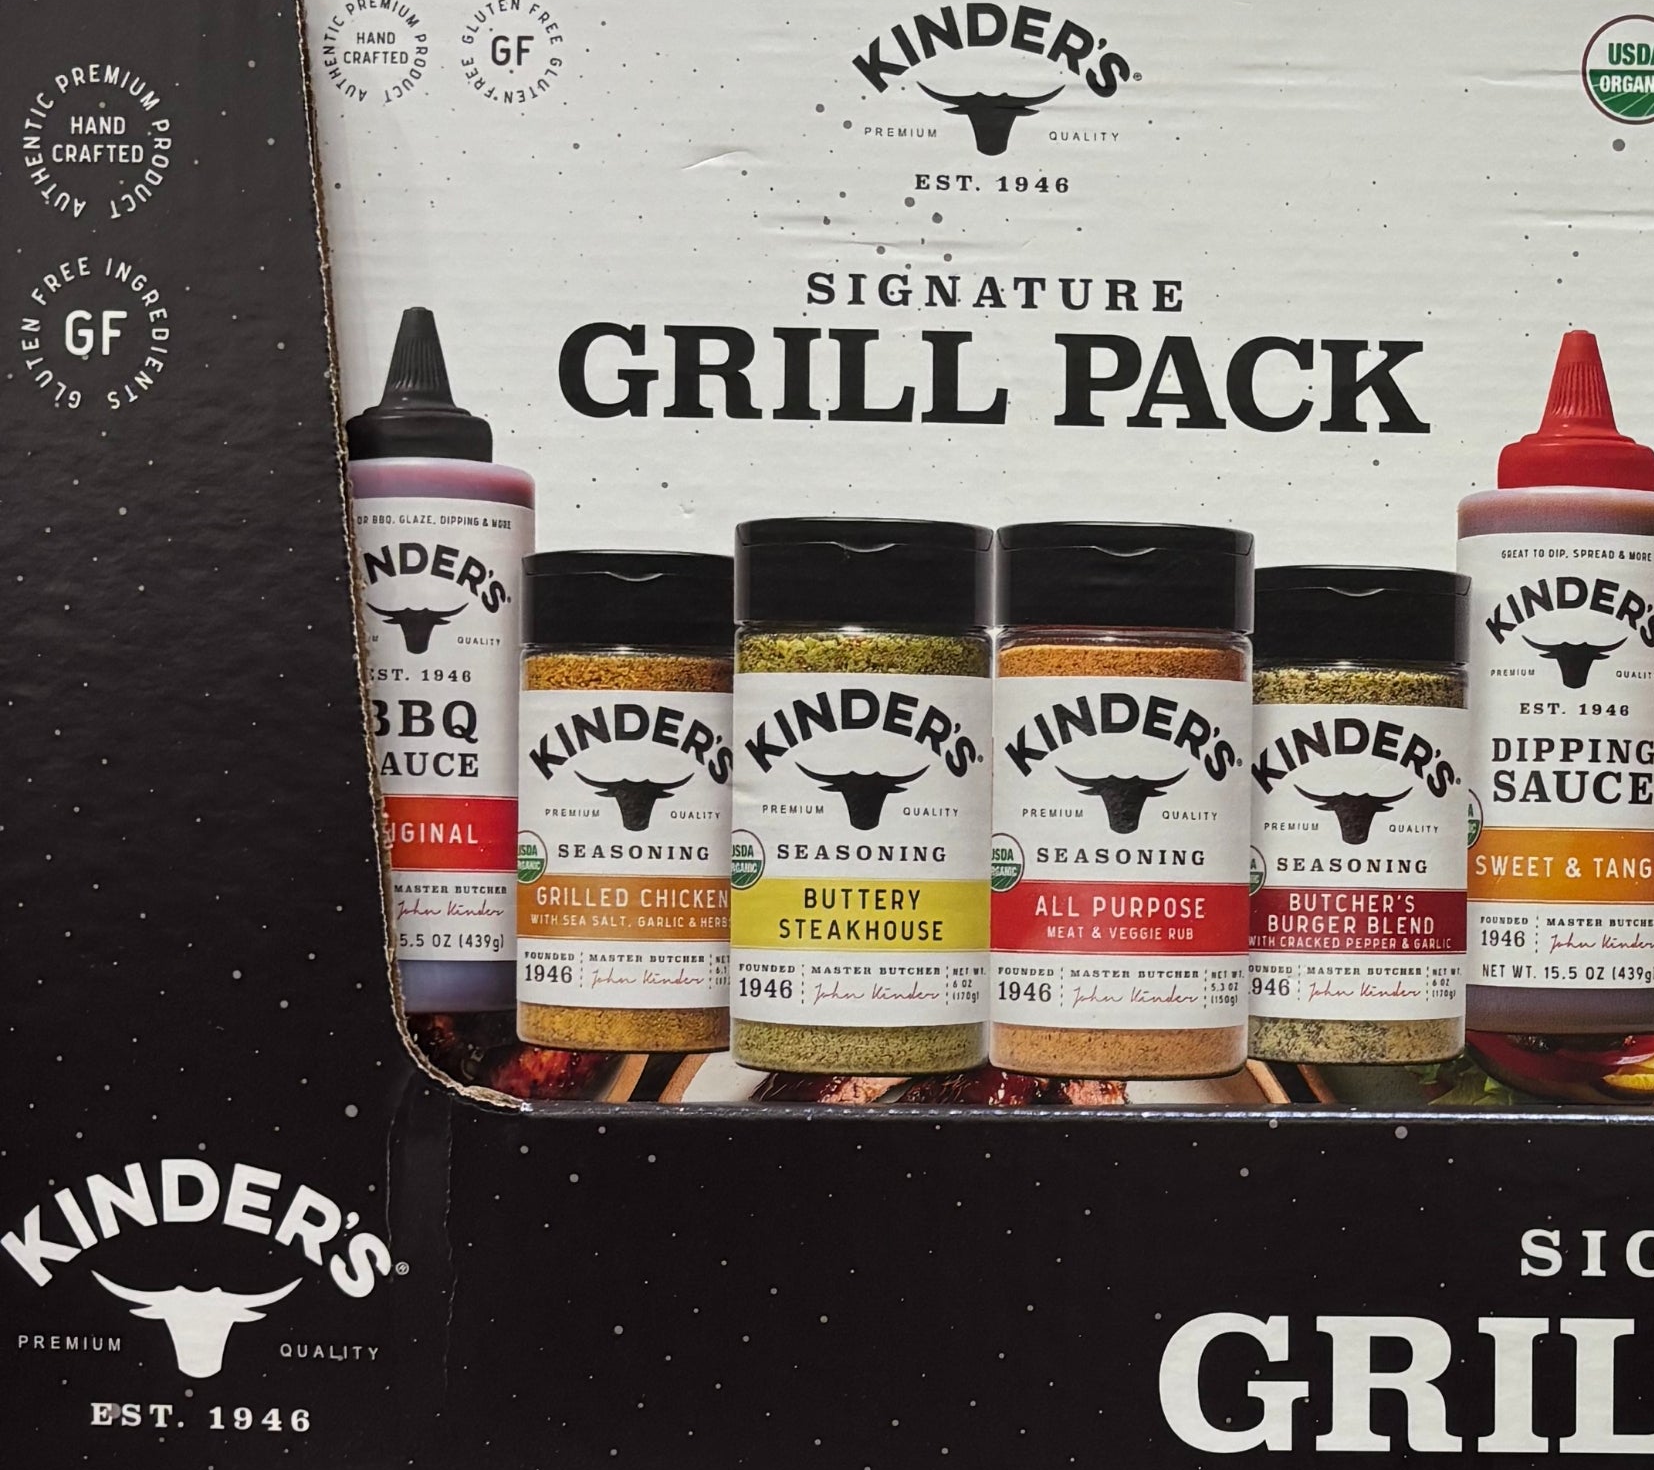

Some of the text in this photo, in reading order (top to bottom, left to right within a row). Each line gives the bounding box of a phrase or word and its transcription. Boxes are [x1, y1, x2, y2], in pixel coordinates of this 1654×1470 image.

[356, 31, 396, 45] HAND
[343, 51, 409, 64] CRAFTED
[491, 36, 534, 66] GF
[851, 2, 1131, 98] KINDER'S
[70, 116, 127, 135] HAND
[864, 126, 1120, 142] PREMIUM QUALITY
[23, 63, 173, 219] AUTHENTIC PREMIUM PRODUCT
[52, 144, 144, 163] CRAFTED
[914, 174, 1070, 193] EST. 1946
[805, 271, 1187, 314] SIGNATURE
[20, 256, 170, 410] GLUTEN FREE INGREDIENTS
[65, 309, 128, 356] GF
[557, 321, 1432, 434] GRILL PACK
[1501, 549, 1529, 559] GREAT
[1534, 549, 1545, 558] TO
[1573, 550, 1615, 559] SPREAD
[1619, 551, 1626, 560] &
[1629, 551, 1652, 562] MORE
[1520, 703, 1629, 716] EST. 1946
[744, 687, 977, 778] KINDER'S
[1004, 692, 1235, 783] KINDER'S
[1493, 770, 1654, 805] SAUCE
[558, 843, 711, 862] SEASONING
[776, 844, 947, 862] SEASONING
[1036, 847, 1206, 866] SEASONING
[1475, 855, 1554, 877] SWEET
[1565, 857, 1581, 878] &
[536, 885, 728, 909] GRILLED CHICKEN
[804, 888, 921, 910] BUTTERY
[1289, 893, 1416, 913] BUTCHER'S
[1035, 895, 1206, 920] ALL PURPOSE
[530, 913, 559, 926] WITH
[563, 914, 587, 926] SEA
[638, 915, 684, 929] GARLIC
[689, 915, 697, 928] &
[778, 918, 944, 941] STEAKHOUSE
[1267, 915, 1435, 935] BURGER BLEND
[1480, 916, 1528, 925] FOUNDED
[1546, 918, 1602, 927] MASTER
[1047, 926, 1194, 941] MEAT & VEGGIE RUB
[1481, 930, 1525, 947] 1946
[1482, 964, 1506, 978] NET
[1513, 965, 1537, 979] WT.
[1544, 966, 1577, 980] 15.5
[1586, 967, 1605, 980] OZ
[0, 1157, 393, 1298] KINDER'S
[90, 1402, 312, 1432] EST. 1946
